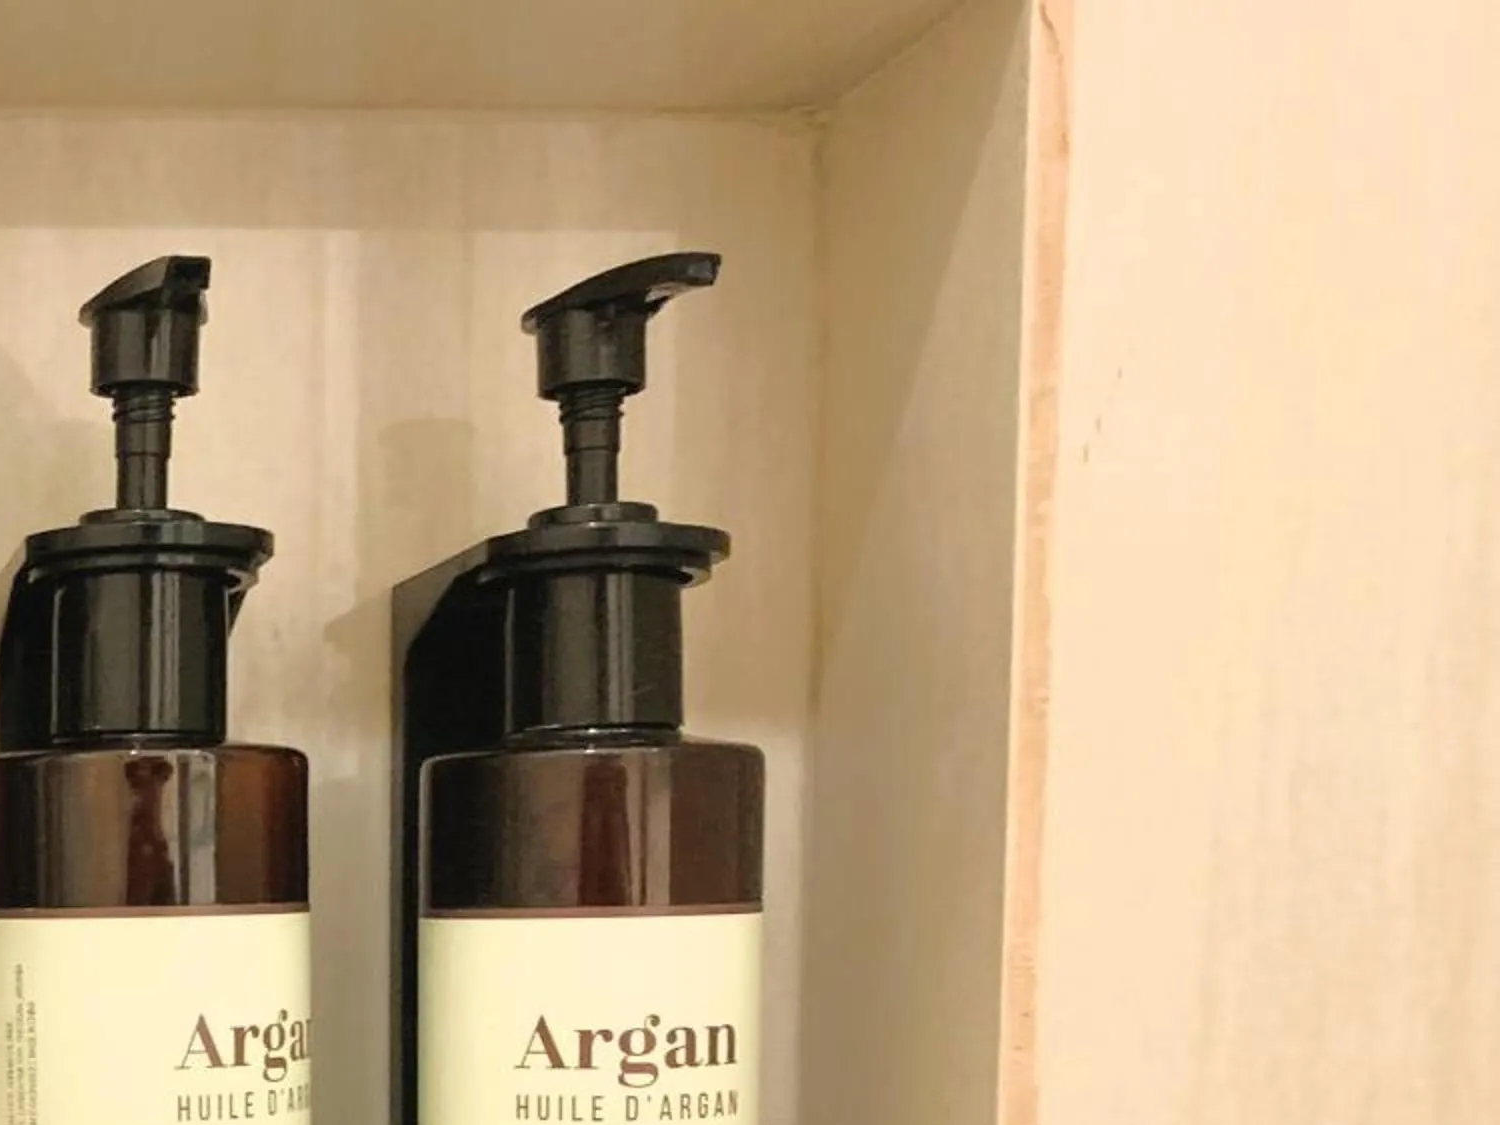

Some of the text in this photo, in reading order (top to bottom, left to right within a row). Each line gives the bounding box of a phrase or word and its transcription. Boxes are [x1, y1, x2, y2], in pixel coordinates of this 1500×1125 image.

[513, 1013, 738, 1089] Argan
[177, 1091, 255, 1122] HUILE
[515, 1089, 739, 1122] HUILE D'ARGAN
